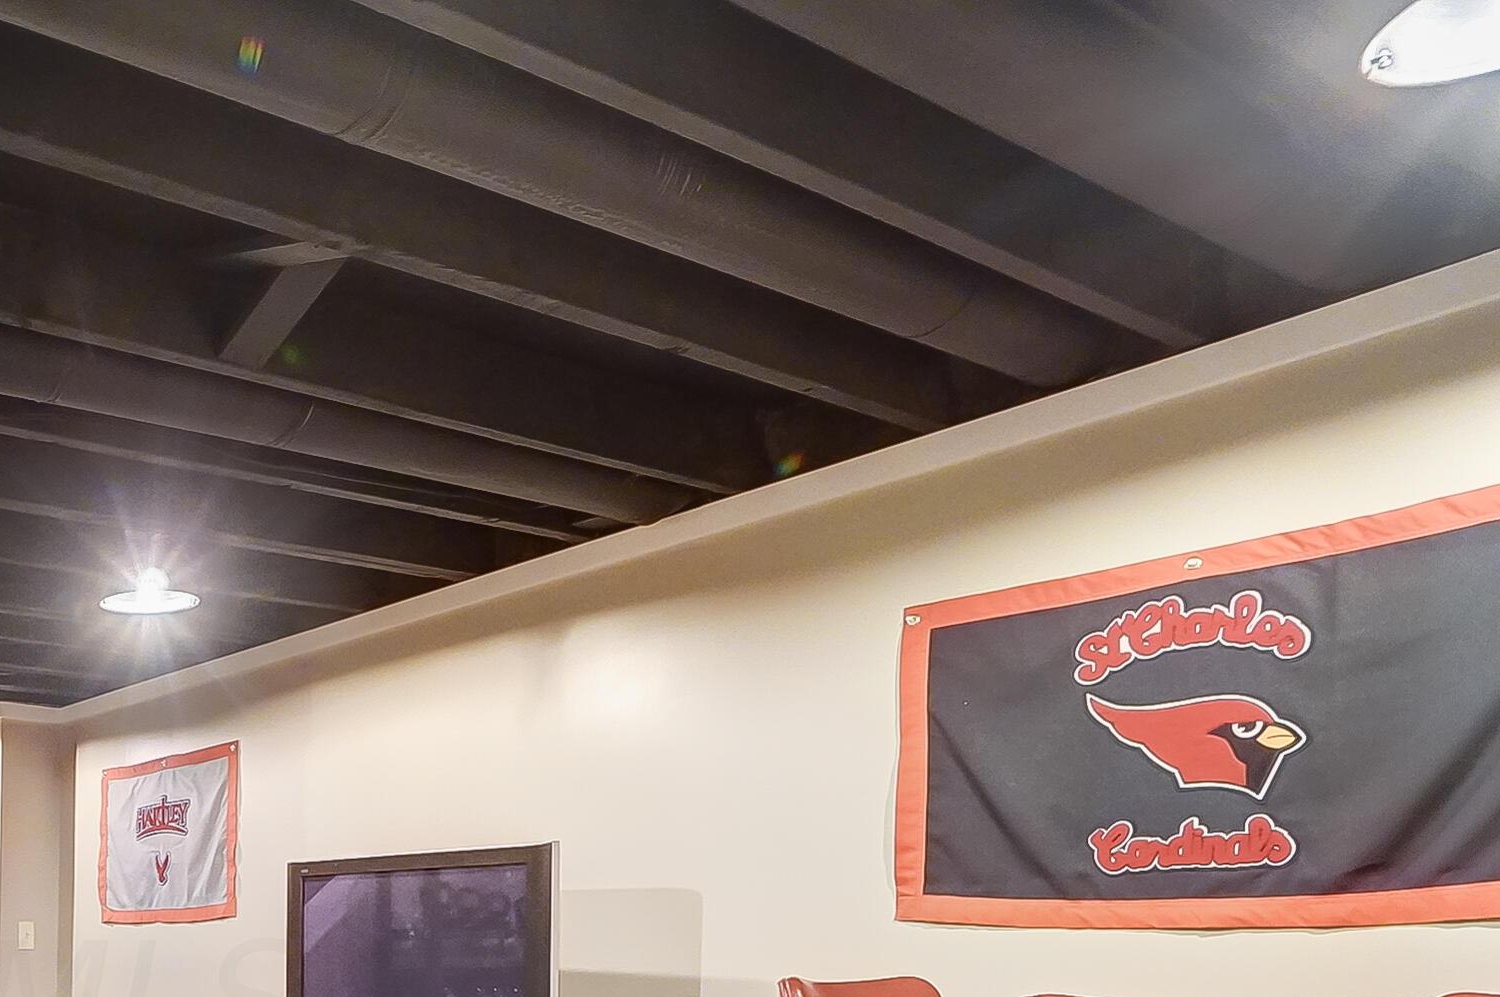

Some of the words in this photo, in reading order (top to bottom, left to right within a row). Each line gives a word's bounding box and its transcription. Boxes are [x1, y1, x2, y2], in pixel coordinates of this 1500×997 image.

[1074, 615, 1137, 685] St
[1122, 590, 1311, 660] Charles
[135, 796, 190, 834] HARTLEY
[1088, 814, 1296, 875] Cardinals
